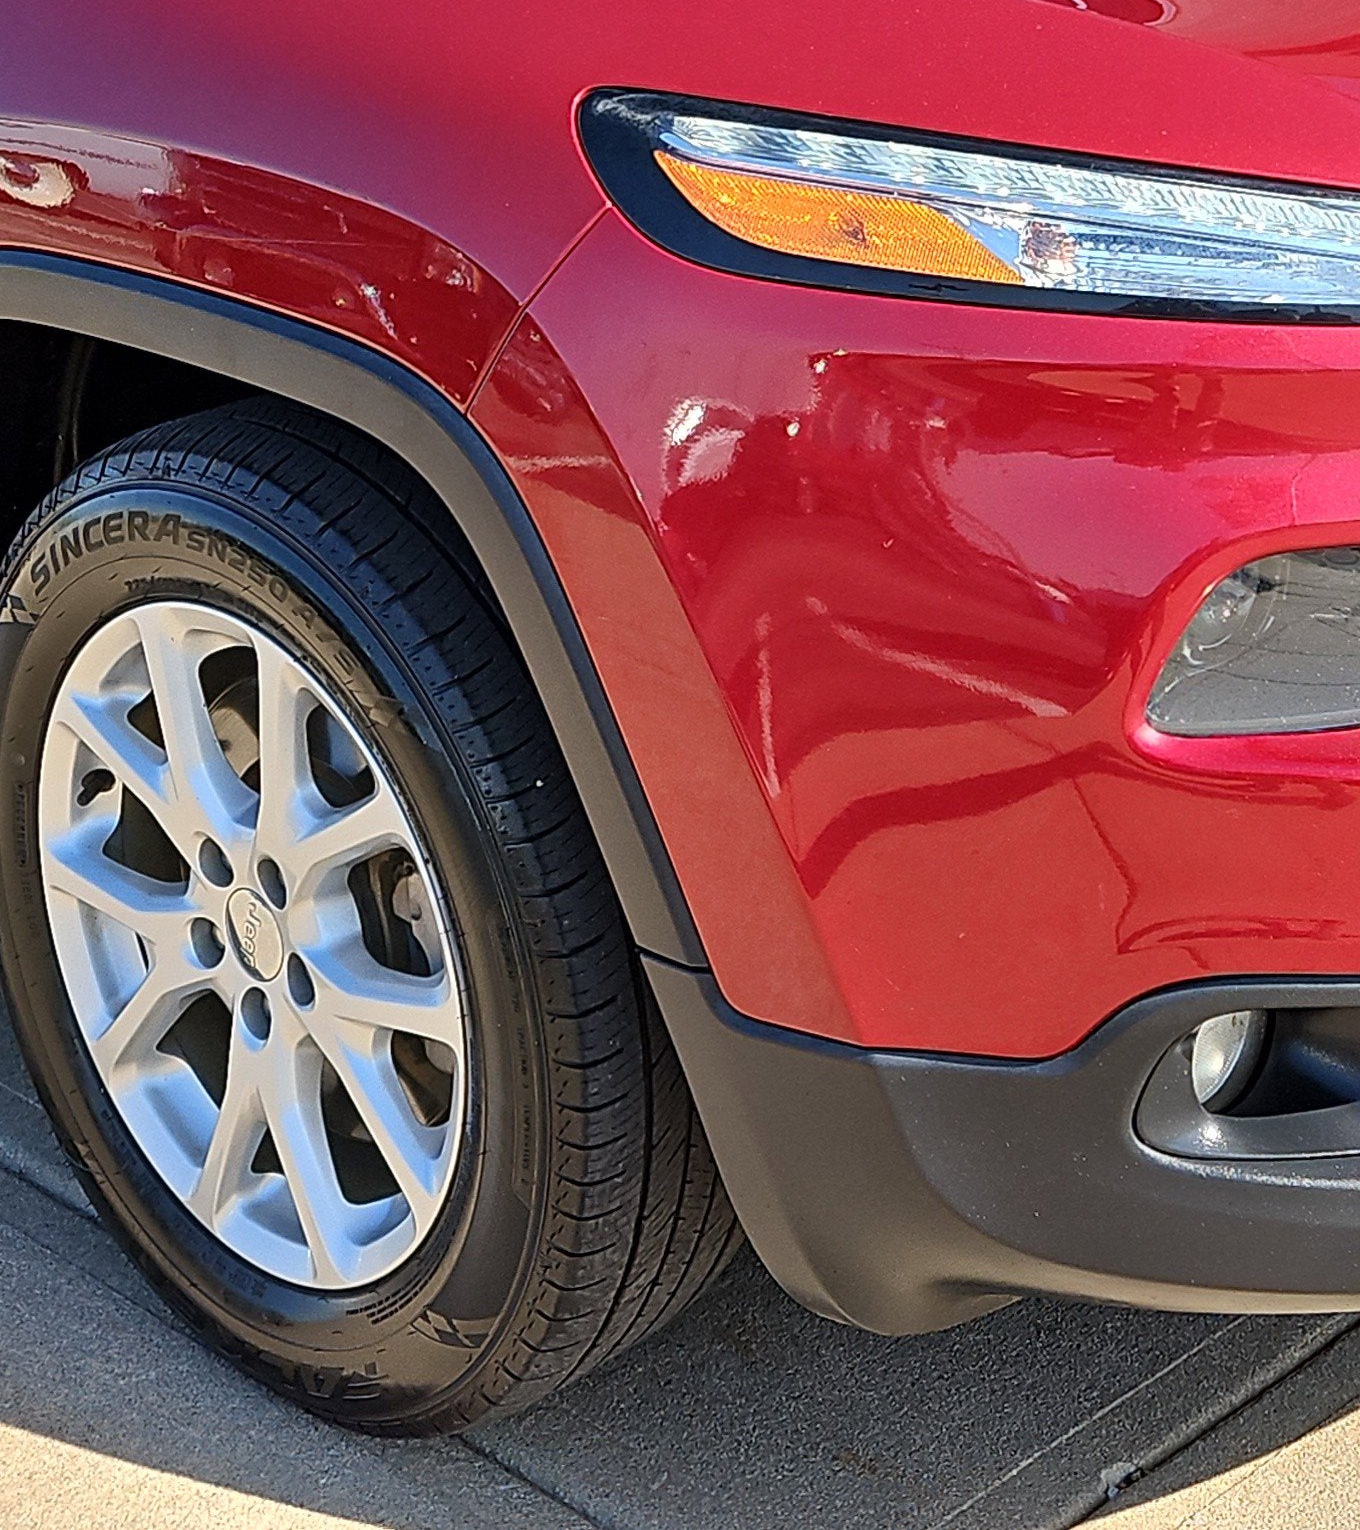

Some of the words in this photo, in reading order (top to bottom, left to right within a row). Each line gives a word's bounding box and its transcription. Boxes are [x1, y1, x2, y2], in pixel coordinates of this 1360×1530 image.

[31, 510, 182, 597] SINCERA
[186, 528, 291, 604] SN250
[239, 900, 263, 969] Jeep
